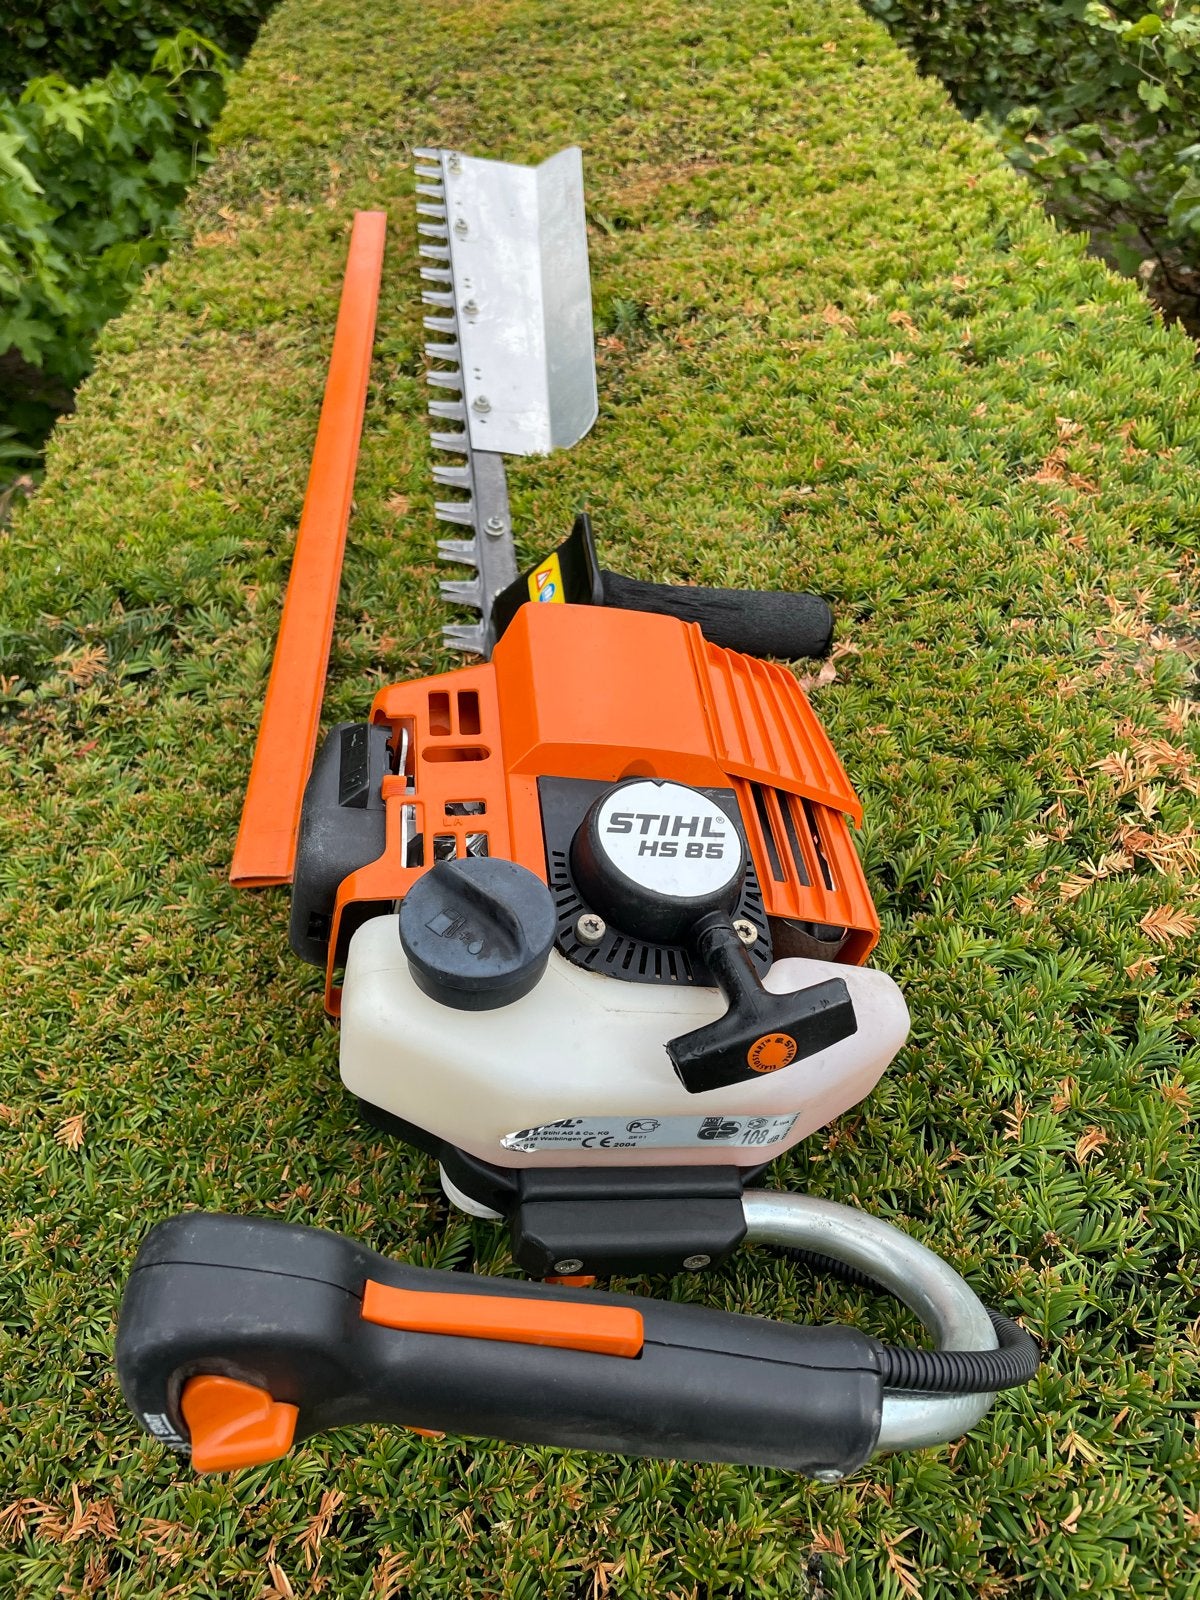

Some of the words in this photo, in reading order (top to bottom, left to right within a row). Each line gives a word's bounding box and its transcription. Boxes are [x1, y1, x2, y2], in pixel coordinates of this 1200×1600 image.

[606, 812, 725, 838] STIHL
[638, 840, 679, 858] HS
[684, 842, 724, 860] 85
[741, 1129, 770, 1145] 108
